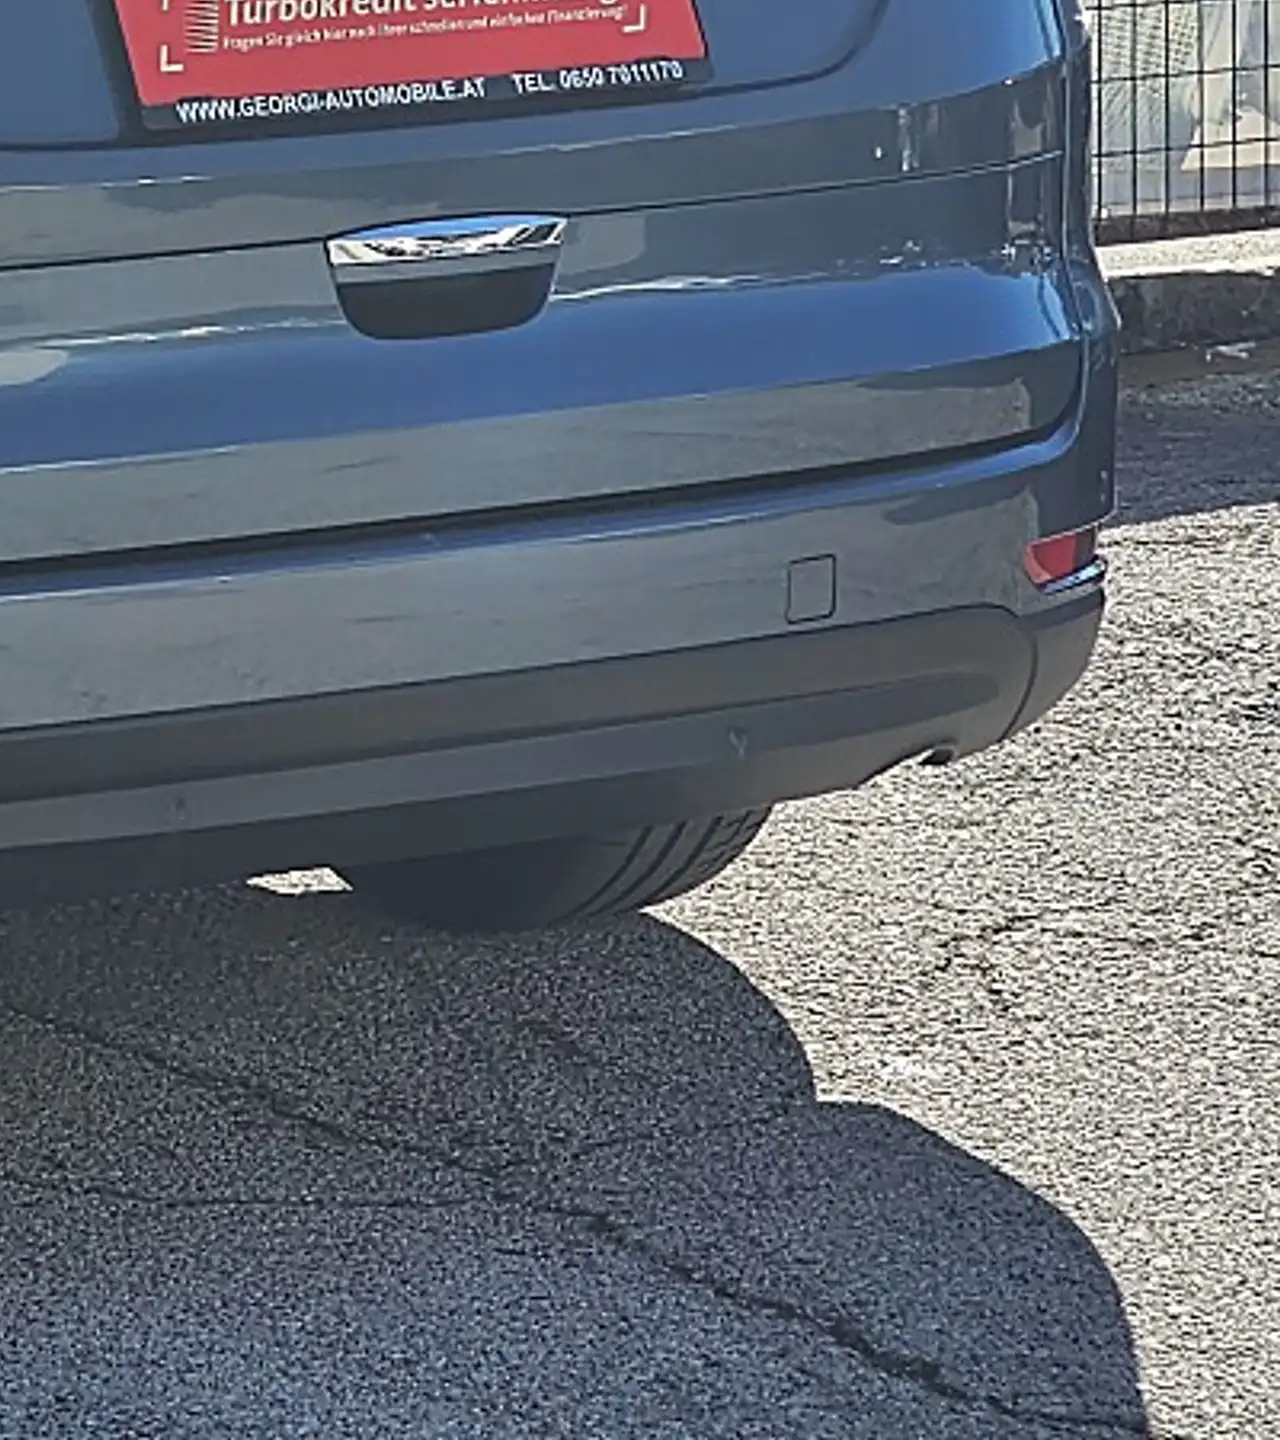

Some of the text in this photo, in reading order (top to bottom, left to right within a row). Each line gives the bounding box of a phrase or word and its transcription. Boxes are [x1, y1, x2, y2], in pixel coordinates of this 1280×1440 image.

[176, 77, 486, 123] WWW.GEORGI-AUTOMOBILE.AT
[559, 67, 604, 88] 0650
[607, 61, 683, 84] 7011170
